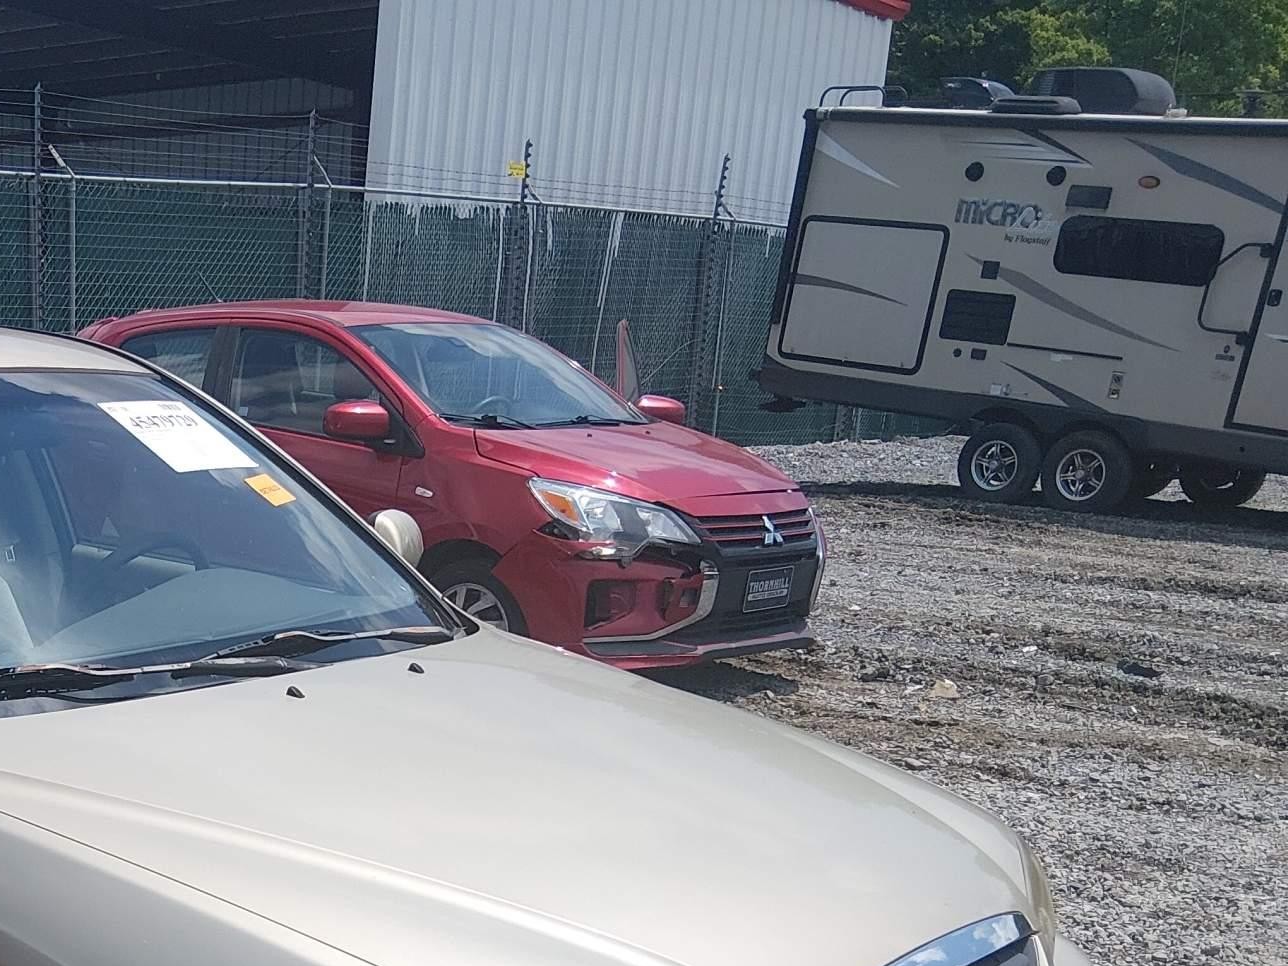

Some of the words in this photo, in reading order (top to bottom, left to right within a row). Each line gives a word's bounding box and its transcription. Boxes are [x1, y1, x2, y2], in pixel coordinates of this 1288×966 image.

[1003, 233, 1013, 243] by
[1014, 234, 1051, 247] Flagstaff
[128, 414, 199, 429] 45479729
[749, 577, 789, 593] THORNHILL
